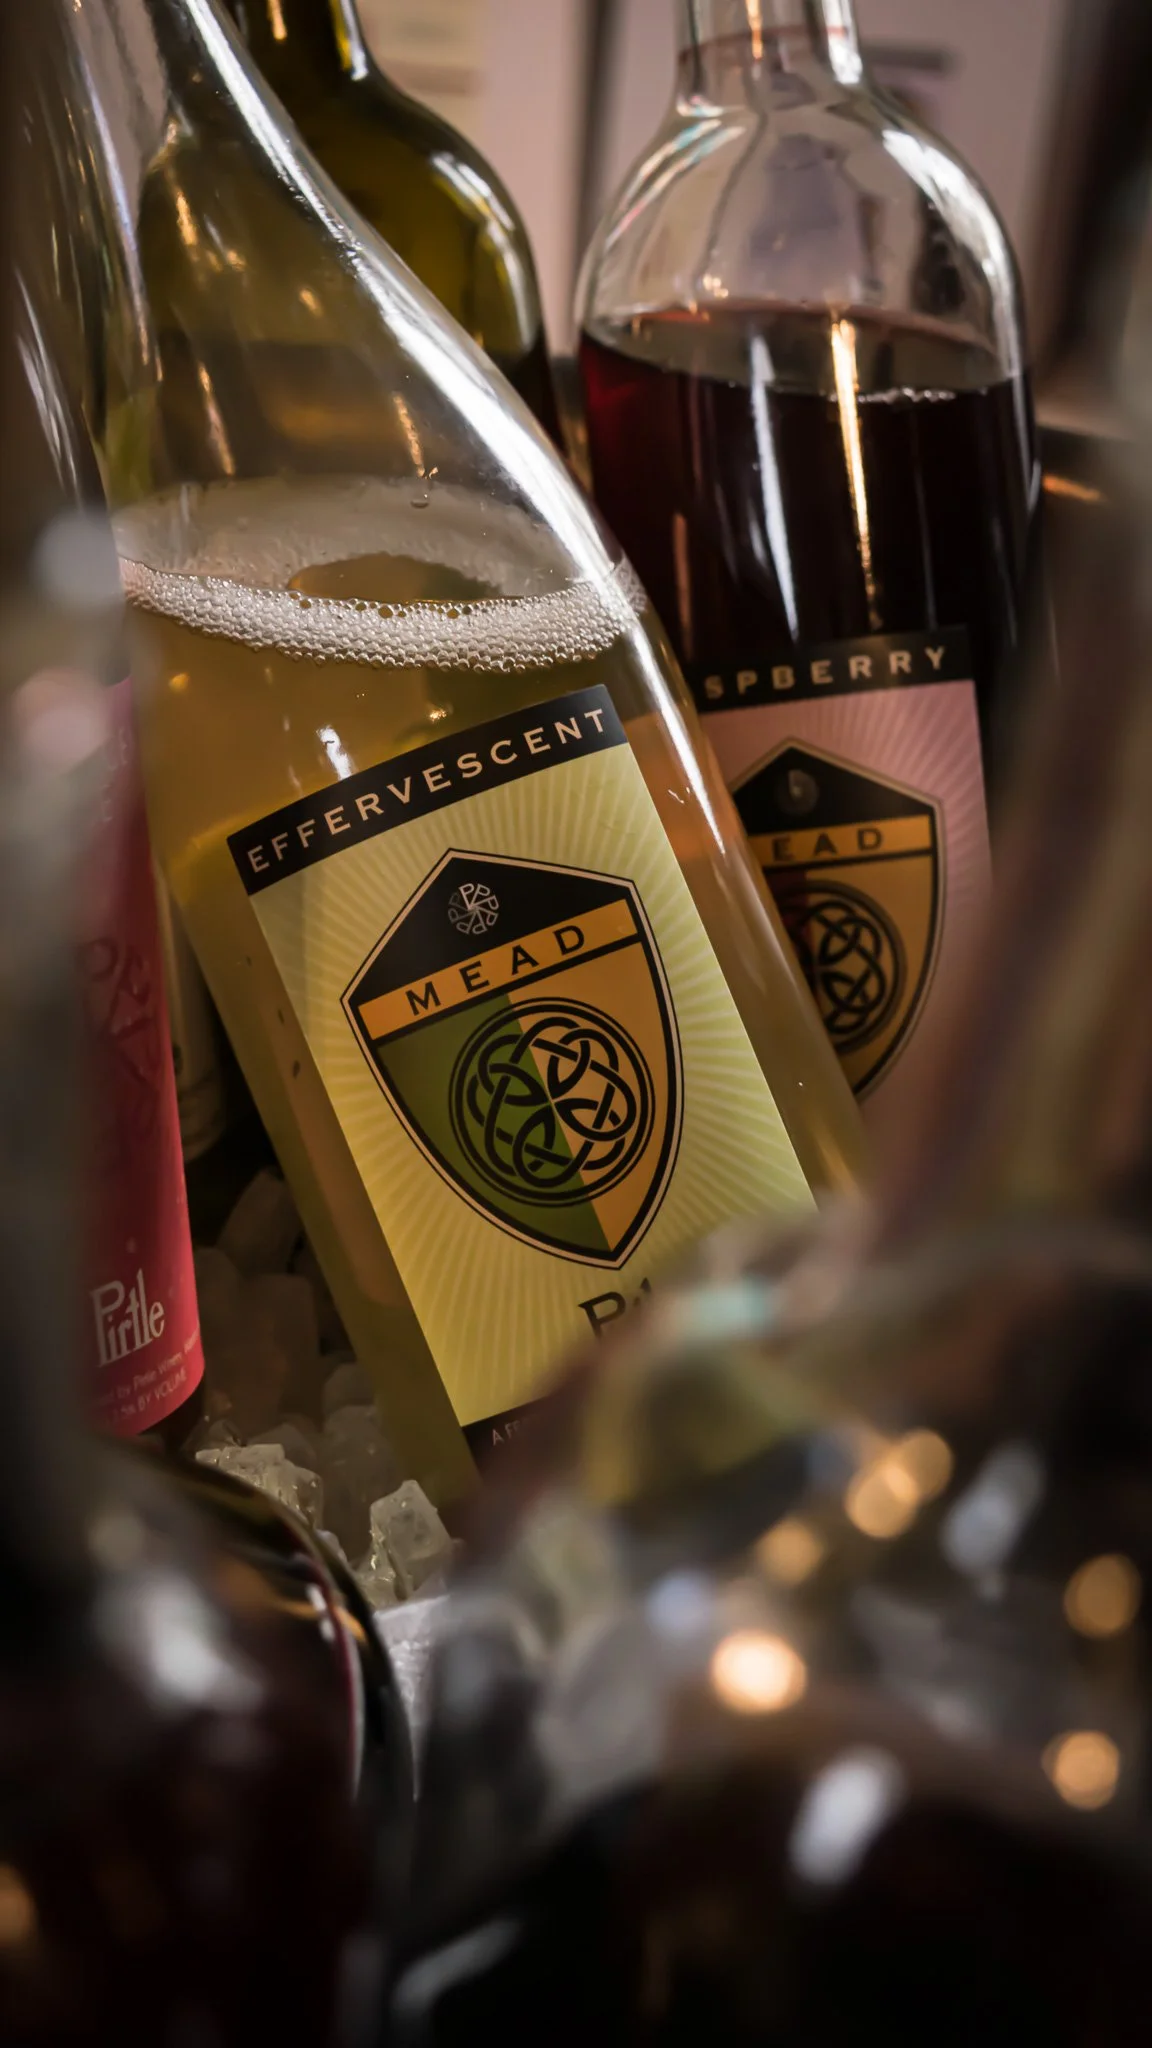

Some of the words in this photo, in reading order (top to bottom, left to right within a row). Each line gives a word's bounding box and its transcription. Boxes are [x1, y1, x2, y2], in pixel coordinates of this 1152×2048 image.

[246, 706, 608, 875] EFFERVESCENT
[404, 924, 586, 1017] MEAD
[88, 1266, 167, 1369] Pirtle
